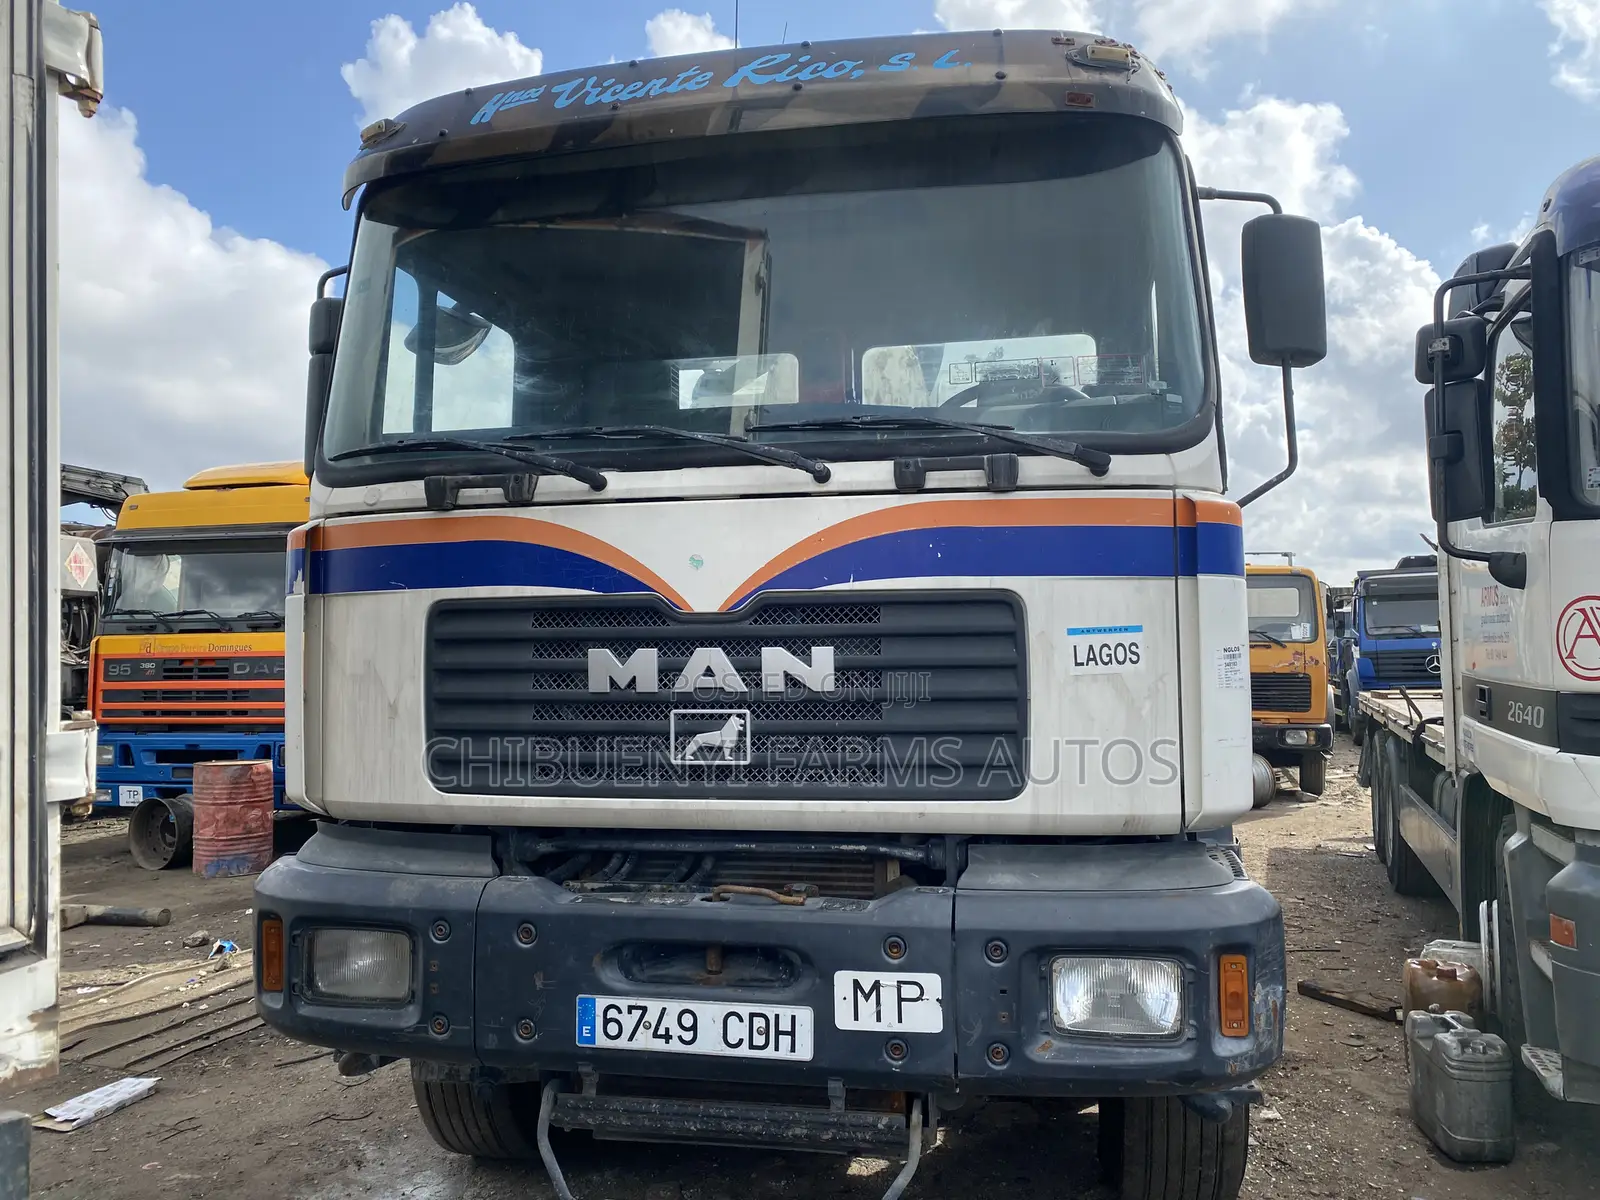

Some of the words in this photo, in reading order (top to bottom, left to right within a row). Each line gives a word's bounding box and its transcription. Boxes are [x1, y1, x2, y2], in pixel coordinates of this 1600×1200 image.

[551, 65, 713, 109] Vicente
[722, 53, 865, 88] Rico,
[878, 52, 919, 72] S.
[932, 49, 973, 70] L.
[208, 643, 252, 654] Domingues
[1073, 641, 1141, 667] LAGOS
[108, 663, 131, 676] 95
[587, 646, 836, 693] MAN
[1507, 700, 1545, 729] 2640
[127, 790, 138, 799] TP
[852, 978, 926, 1025] MP
[582, 1026, 591, 1037] E
[601, 1003, 699, 1046] 6749
[721, 1011, 797, 1054] CDH
